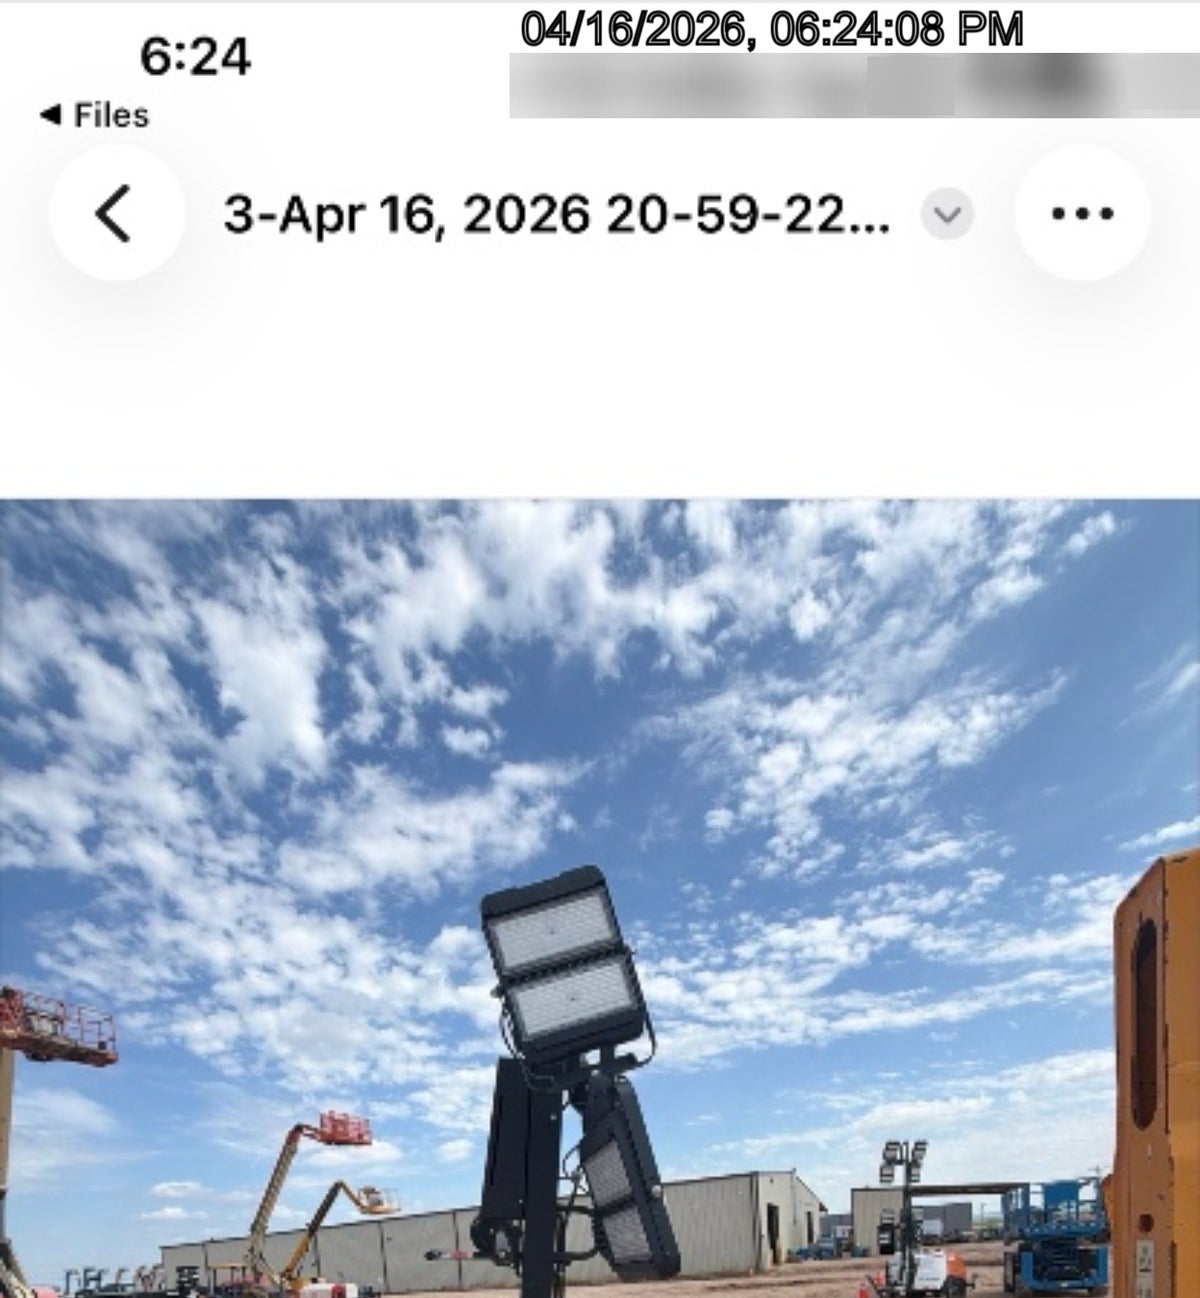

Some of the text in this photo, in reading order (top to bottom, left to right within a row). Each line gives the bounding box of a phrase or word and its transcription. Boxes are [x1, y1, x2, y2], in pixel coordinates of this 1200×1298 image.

[141, 36, 252, 76] 6:24
[75, 100, 149, 128] Files
[224, 194, 367, 243] 3-Apr
[380, 193, 445, 243] 16,
[464, 193, 590, 235] 2026
